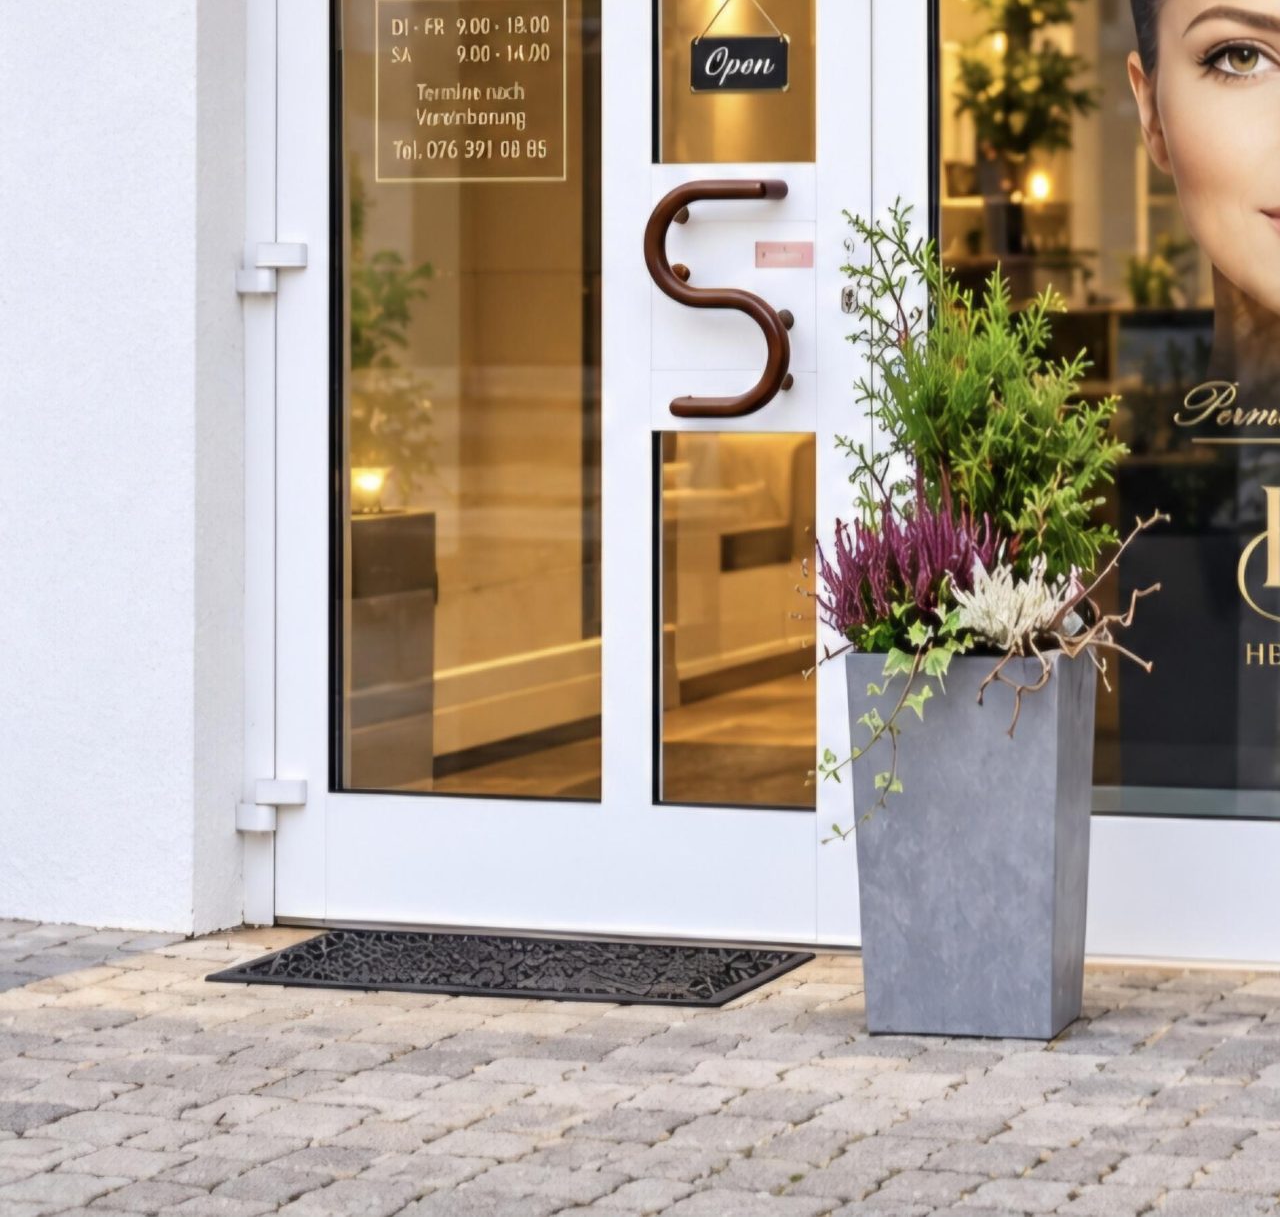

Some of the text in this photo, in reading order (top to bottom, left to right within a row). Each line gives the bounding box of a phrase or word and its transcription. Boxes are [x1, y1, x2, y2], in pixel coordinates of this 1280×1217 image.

[391, 18, 409, 36] DI
[424, 17, 444, 35] FR
[456, 17, 490, 35] 9.00
[391, 45, 412, 63] SA
[456, 45, 490, 63] 9.00
[427, 140, 459, 159] 076
[464, 139, 492, 159] 391
